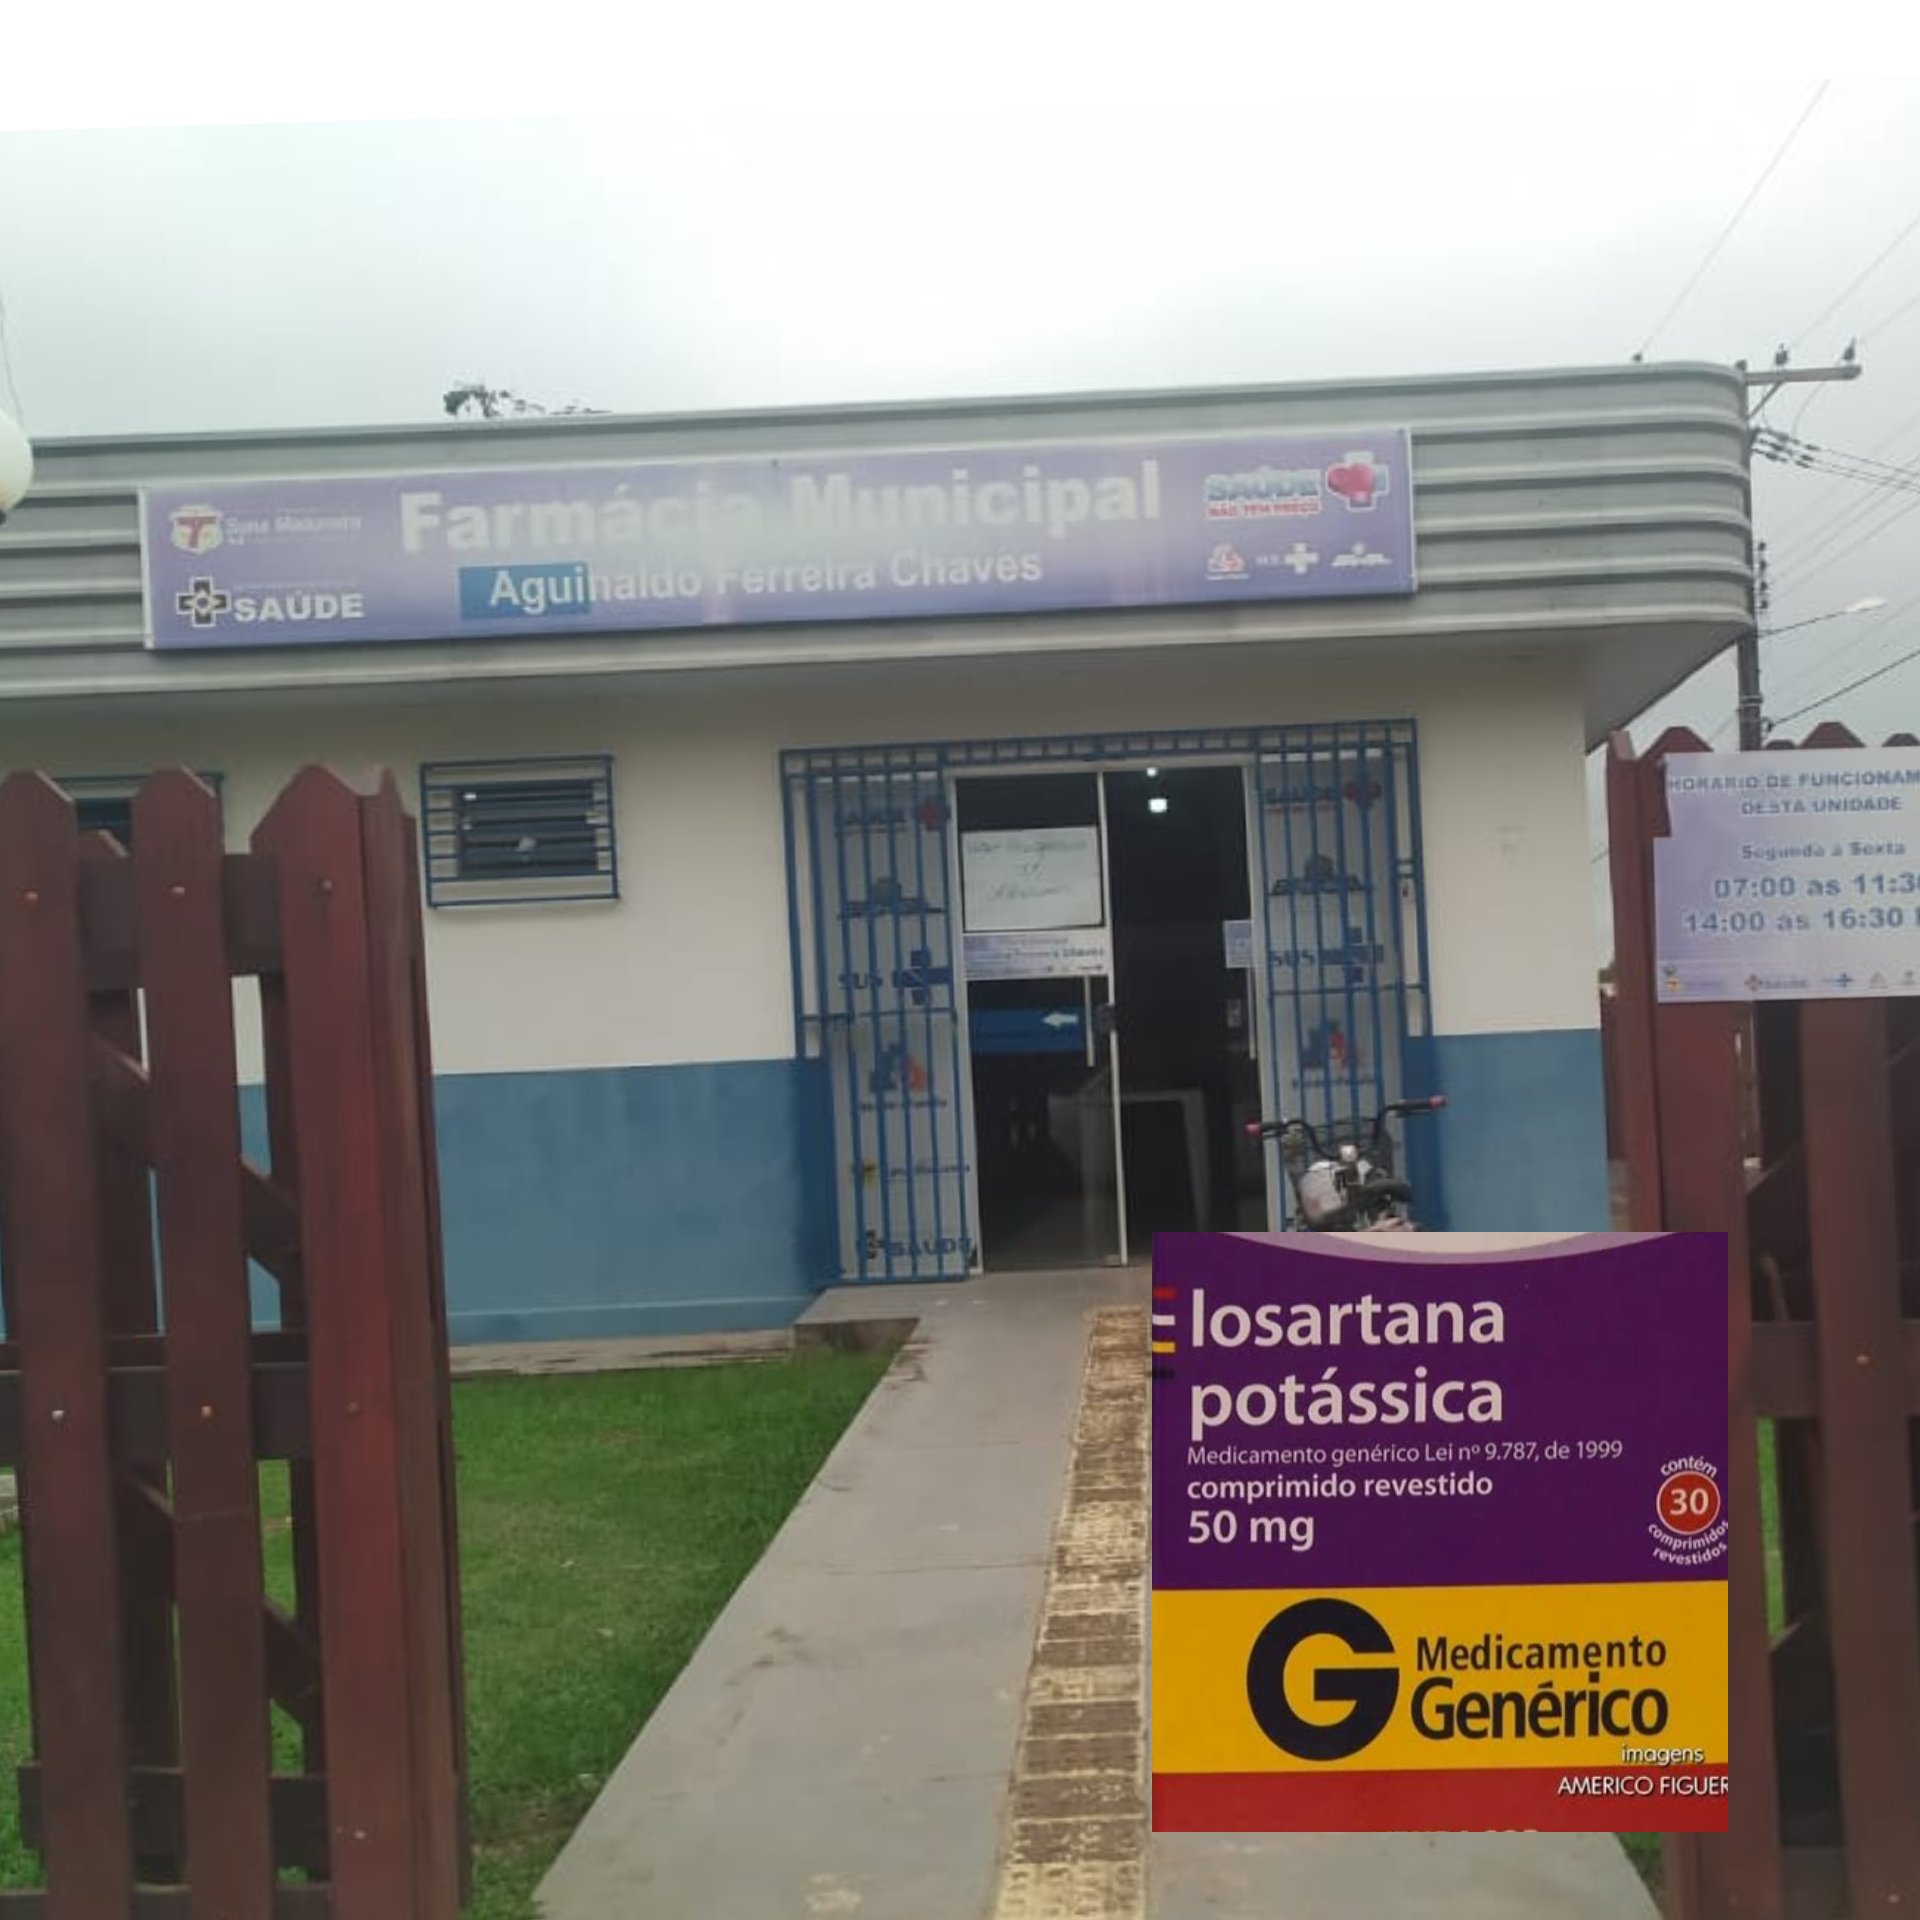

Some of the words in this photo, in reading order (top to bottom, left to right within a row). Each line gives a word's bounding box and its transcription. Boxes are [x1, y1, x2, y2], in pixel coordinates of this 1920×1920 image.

[401, 478, 762, 554] Farmácia
[790, 459, 1161, 538] Municipal
[489, 564, 702, 615] Aguinaldo
[716, 556, 877, 595] Ferreira
[233, 589, 366, 622] SAÚDE
[1766, 774, 1792, 789] DE
[1741, 800, 1806, 815] DESTA
[1812, 796, 1903, 813] UNIDADE
[1741, 843, 1825, 861] Segunda
[1850, 842, 1907, 857] Sexta
[1714, 876, 1796, 898] 07:00
[1685, 911, 1765, 932] 14:00
[1823, 906, 1903, 929] 16:30
[1192, 1288, 1505, 1347] losartana
[1190, 1366, 1504, 1441] potássica
[1187, 1446, 1327, 1465] Medicamento
[1331, 1444, 1420, 1468] genérico
[1425, 1443, 1453, 1462] Lei
[1485, 1442, 1540, 1463] 9.787,
[1545, 1440, 1570, 1460] de
[1576, 1440, 1624, 1460] 1999
[1660, 1455, 1718, 1478] contém
[1187, 1472, 1356, 1504] comprimido
[1363, 1470, 1493, 1496] revestido
[1669, 1487, 1709, 1516] 30
[1188, 1510, 1238, 1544] 50
[1250, 1516, 1315, 1552] mg
[1648, 1520, 1728, 1551] comprimidos
[1652, 1541, 1728, 1565] revestidos
[1416, 1634, 1667, 1671] Medicamento
[1410, 1672, 1669, 1740] Genérico
